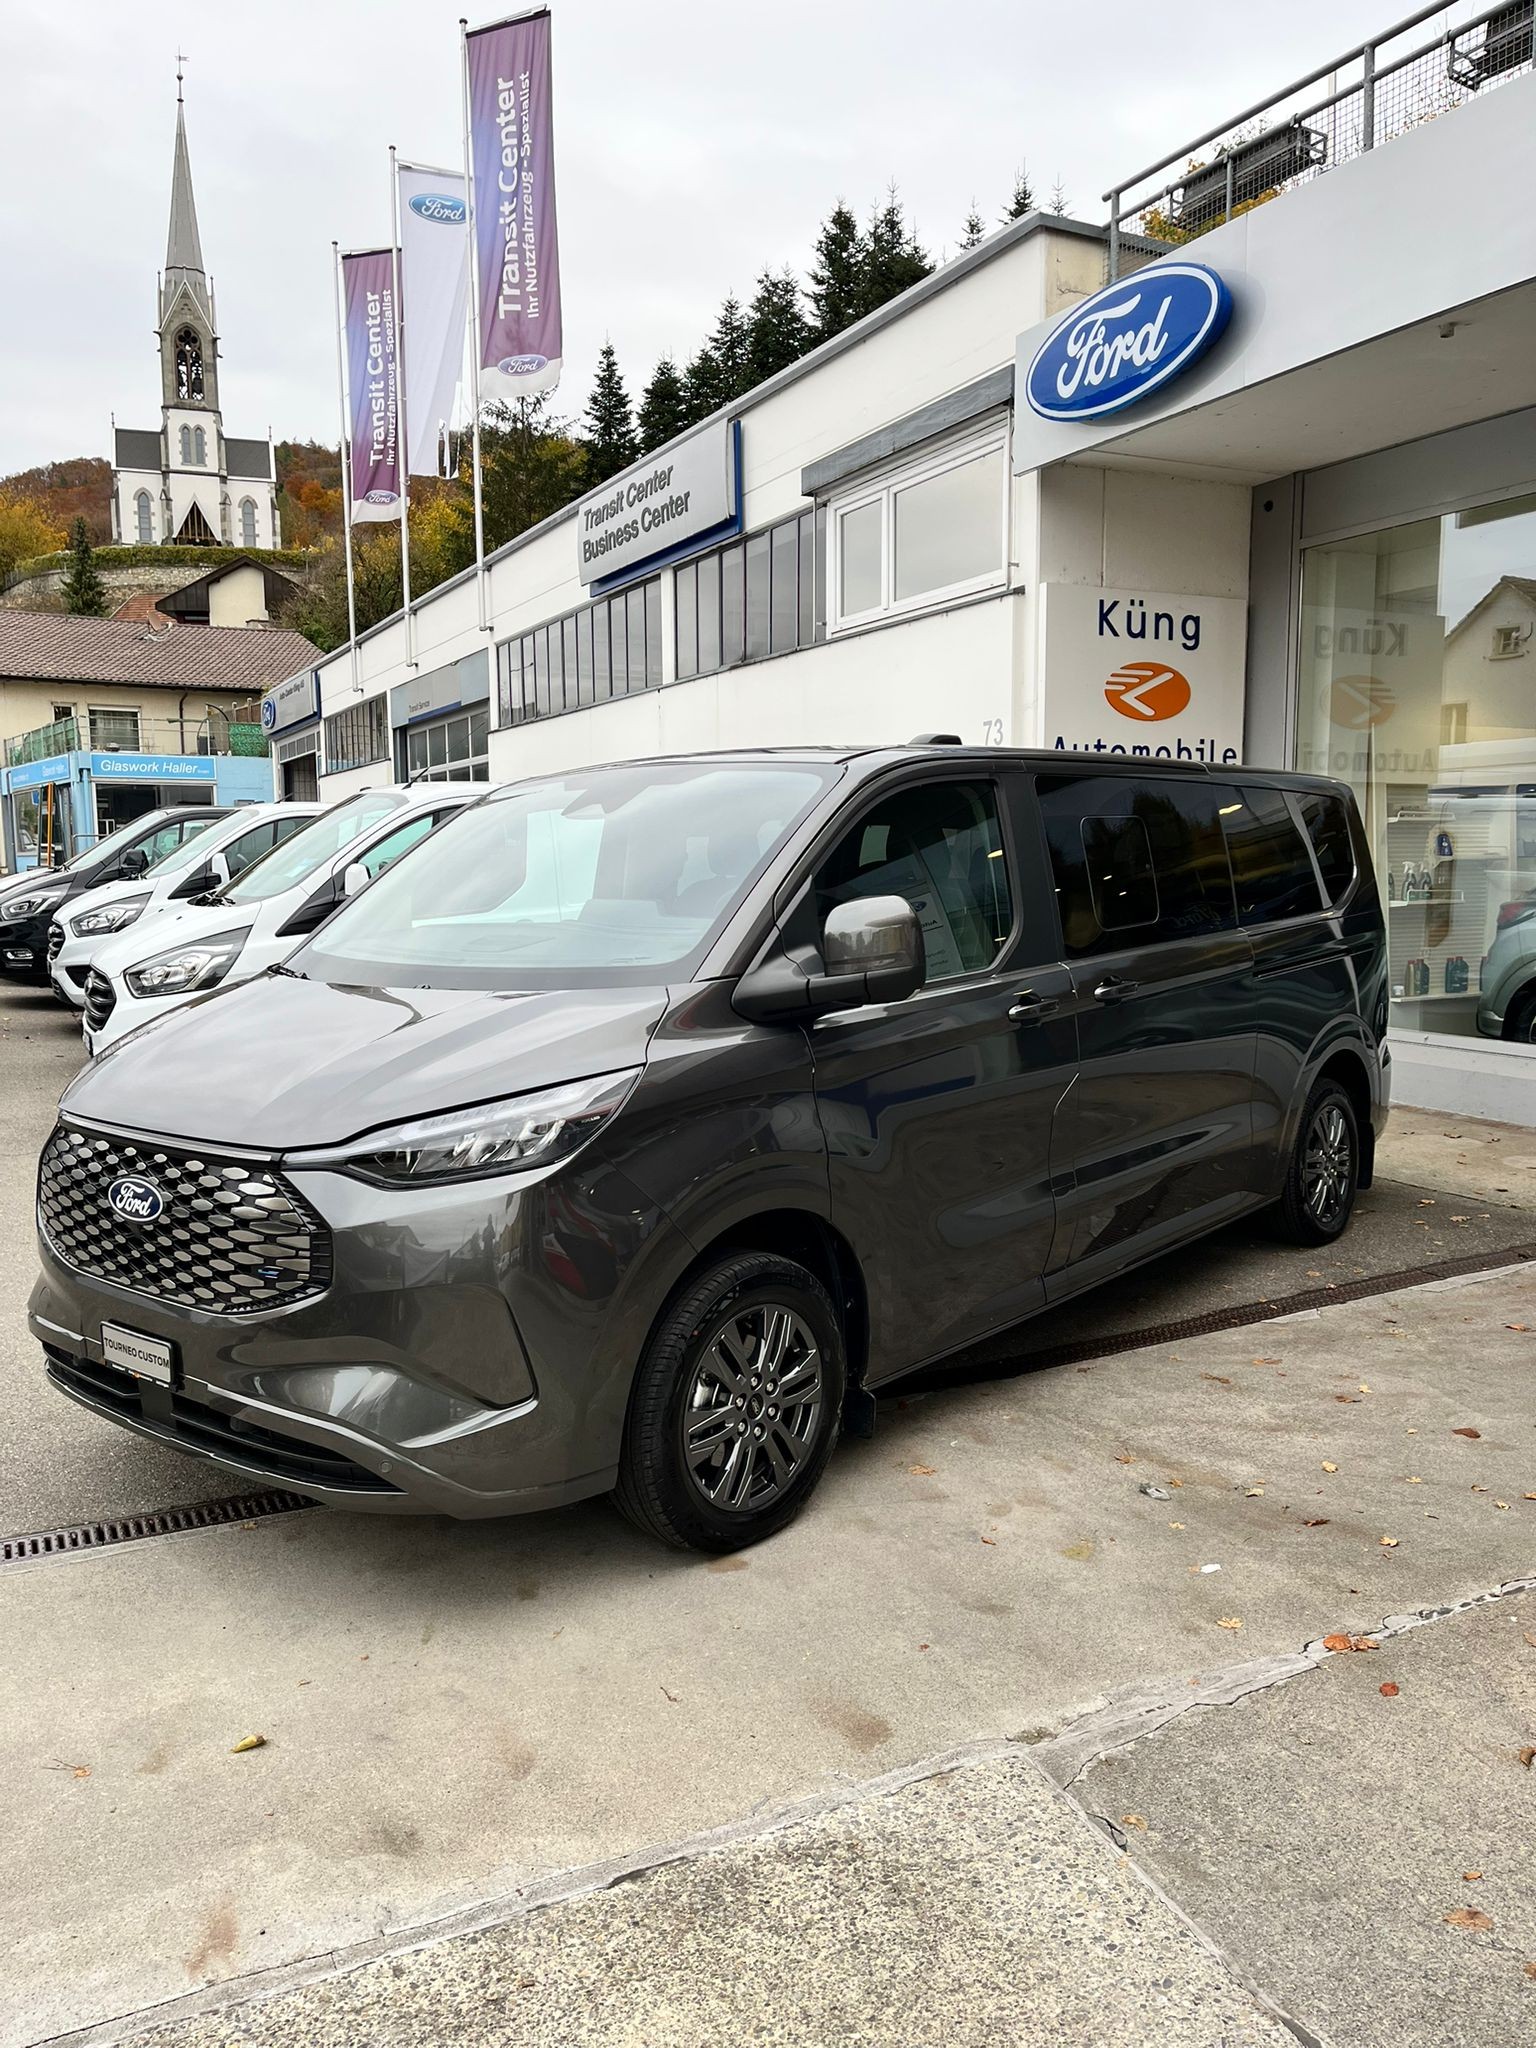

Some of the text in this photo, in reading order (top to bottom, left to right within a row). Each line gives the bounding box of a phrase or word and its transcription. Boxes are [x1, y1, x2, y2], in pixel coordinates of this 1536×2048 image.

[519, 71, 532, 157] Spezialist
[421, 197, 463, 220] Ford
[496, 78, 521, 319] Transit Center
[521, 171, 538, 292] Nutzfahrzeug
[382, 289, 394, 353] Spezialist
[527, 295, 539, 318] Ihr
[508, 357, 539, 373] Ford
[1056, 293, 1172, 399] Ford
[366, 291, 385, 467] Transit Center
[386, 361, 396, 447] Nutzfahrzeug
[387, 448, 395, 466] Ihr
[584, 465, 673, 531] Transit Center
[582, 491, 691, 563] Business Center
[1098, 599, 1201, 650] Küng
[983, 718, 1003, 746] 73
[1055, 736, 1237, 765] tmobile
[100, 759, 198, 774] Glaswork Haller
[116, 1182, 153, 1216] Ford
[104, 1337, 170, 1369] TOURNEO CUSTOM
